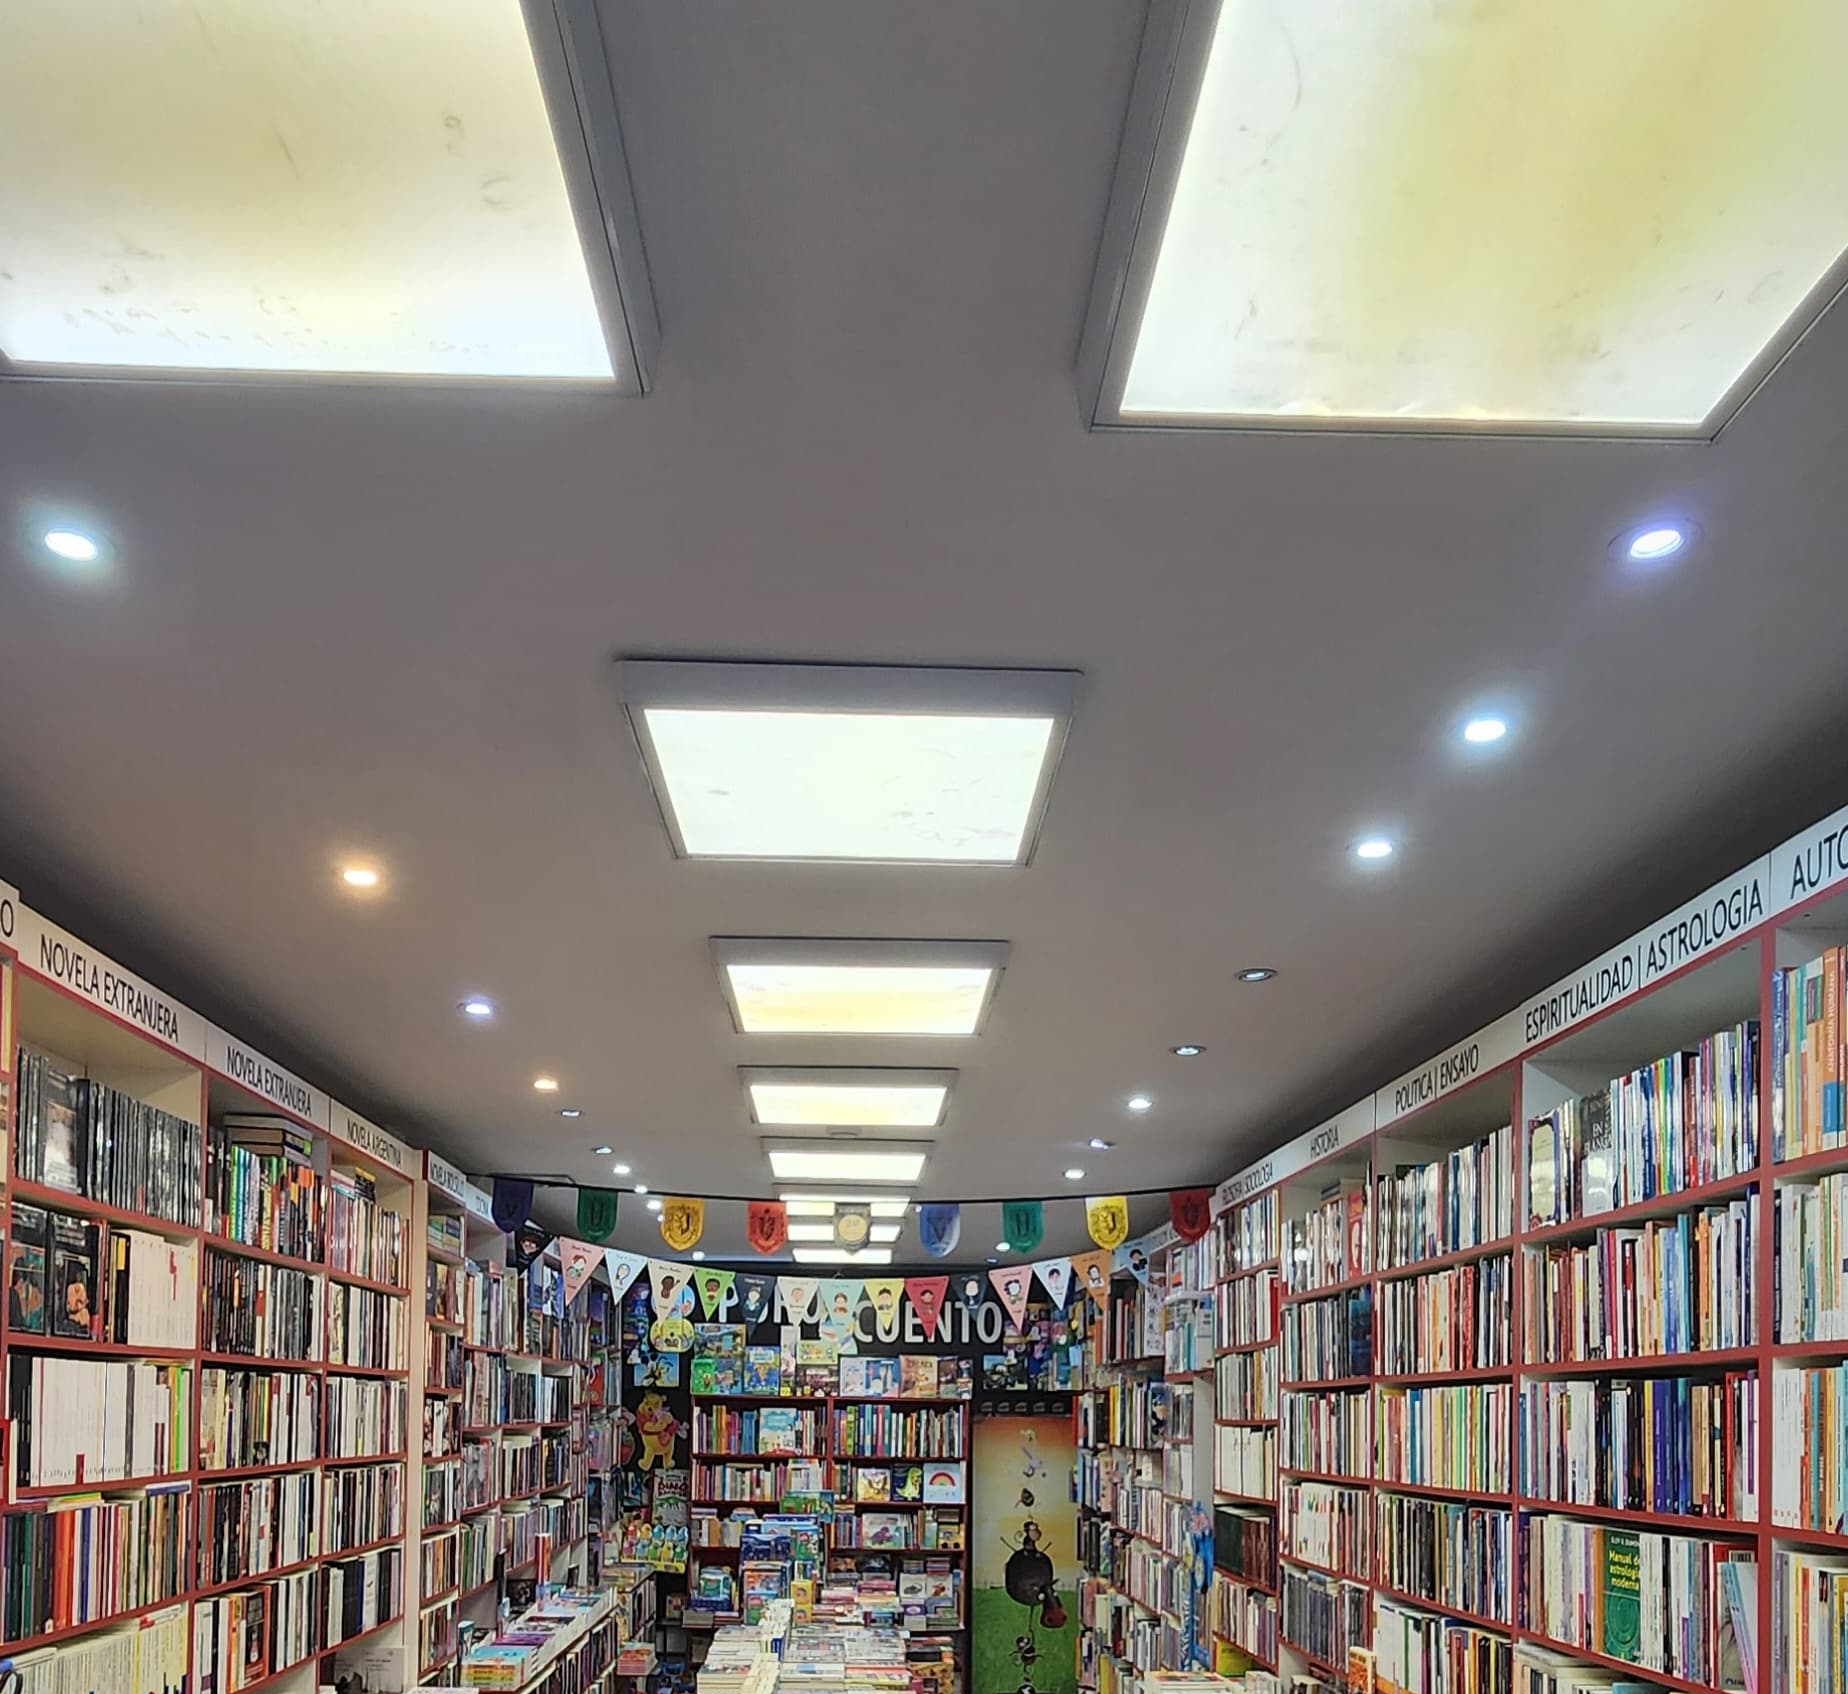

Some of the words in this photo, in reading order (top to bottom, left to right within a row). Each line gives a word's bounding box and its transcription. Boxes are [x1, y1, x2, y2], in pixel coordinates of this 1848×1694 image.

[40, 933, 100, 999] NOVELA
[103, 971, 179, 1043] EXTRANJERA
[1526, 956, 1633, 1043] ESPIRITUALIDAD
[1646, 879, 1763, 978] ASTROLOGIA
[227, 1046, 264, 1091] NOVELA
[265, 1068, 312, 1117] EXTRANJERA
[1395, 1072, 1434, 1115] POLITICA
[1440, 1044, 1480, 1089] ENSAYO
[1609, 1550, 1632, 1564] Manual
